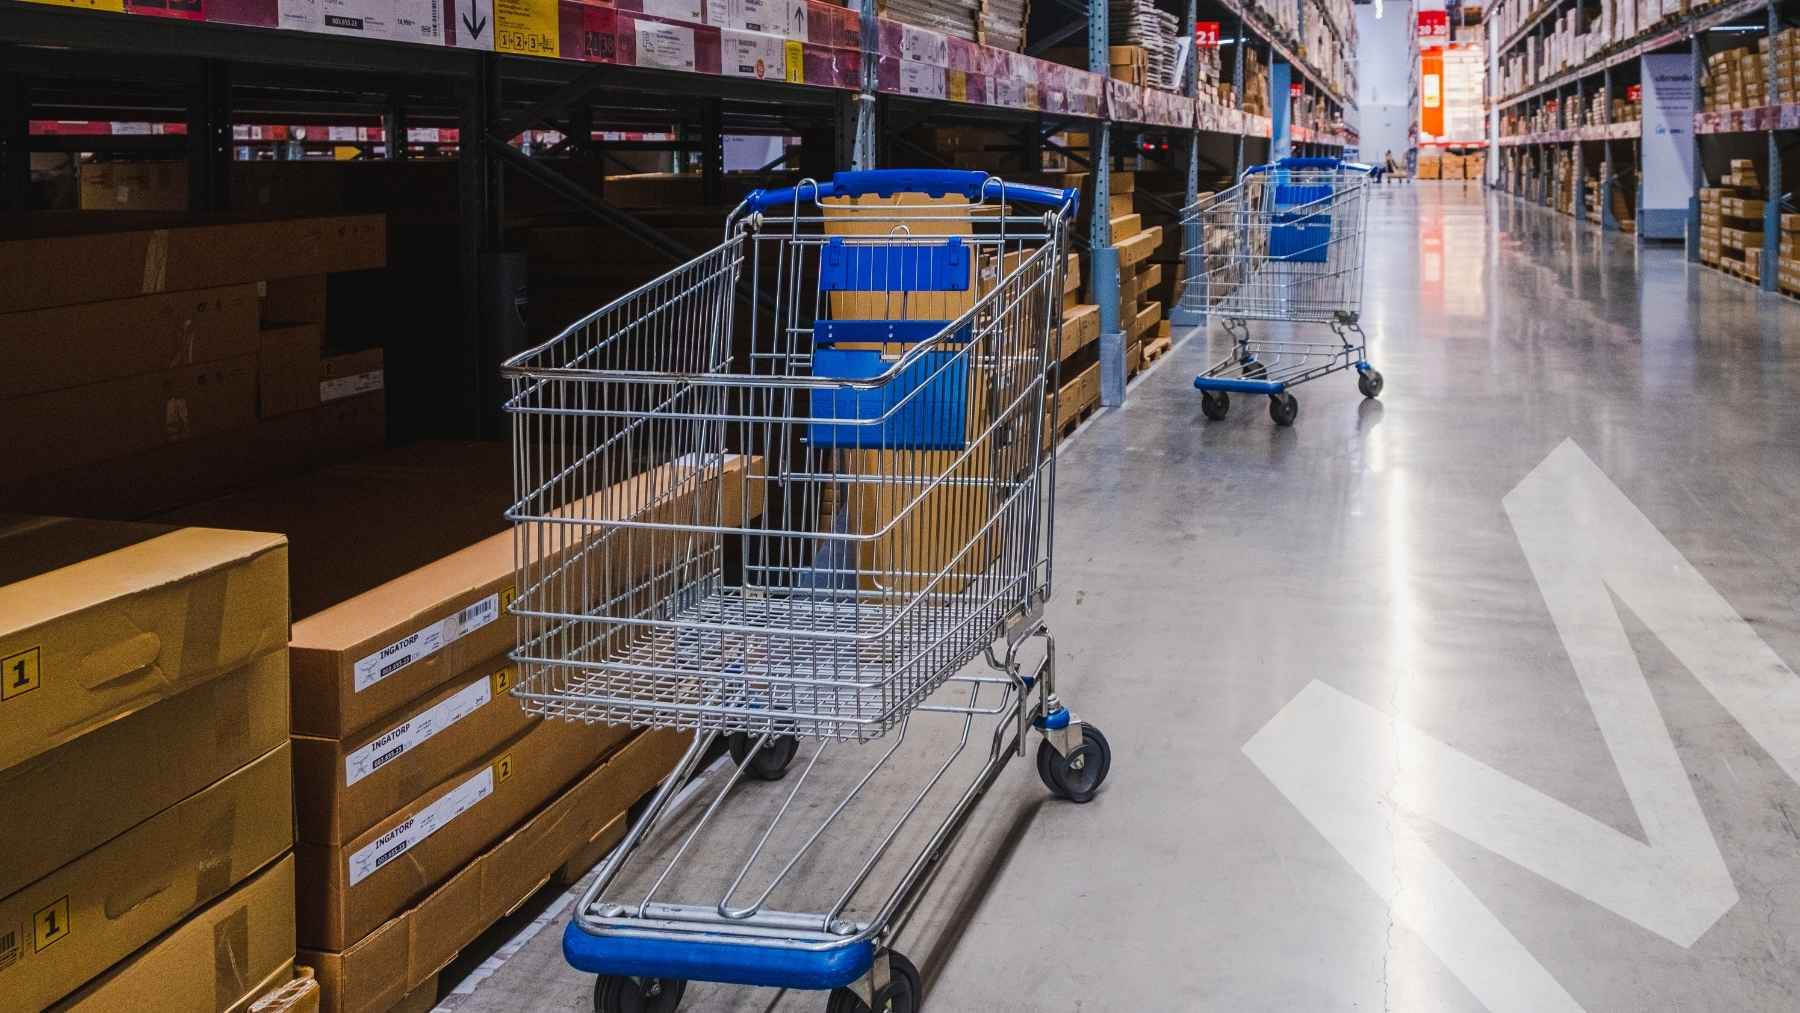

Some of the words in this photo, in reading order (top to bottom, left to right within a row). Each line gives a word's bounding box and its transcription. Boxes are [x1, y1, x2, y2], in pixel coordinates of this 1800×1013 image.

[1196, 31, 1217, 44] 21
[380, 634, 419, 660] INGATORP
[13, 660, 30, 689] 1
[498, 672, 506, 688] 2
[372, 723, 410, 752] INGATORP
[501, 761, 509, 777] 2
[375, 818, 414, 850] INGATORP
[44, 910, 60, 939] 1
